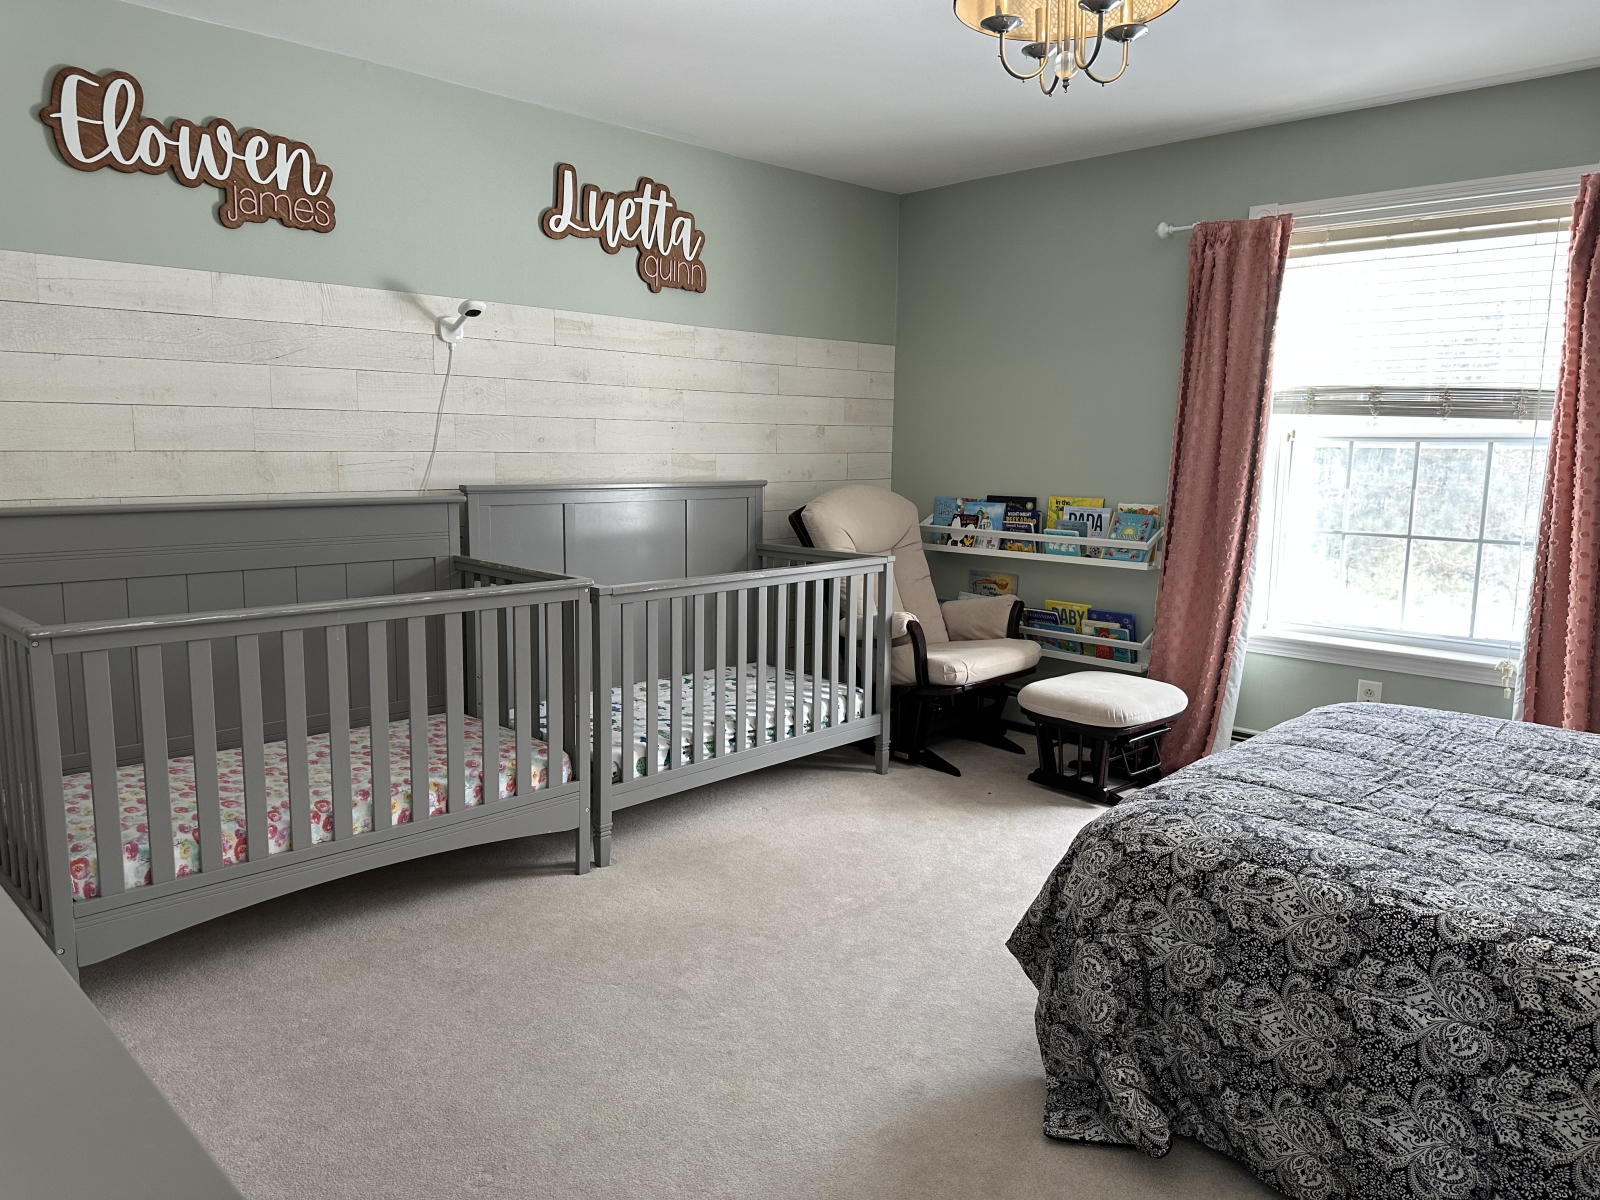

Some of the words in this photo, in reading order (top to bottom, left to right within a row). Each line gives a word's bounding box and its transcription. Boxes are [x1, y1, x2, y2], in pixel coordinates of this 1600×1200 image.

[49, 74, 327, 196] Elowen
[227, 180, 330, 226] james
[549, 169, 702, 261] Luetta
[644, 255, 703, 287] quinn
